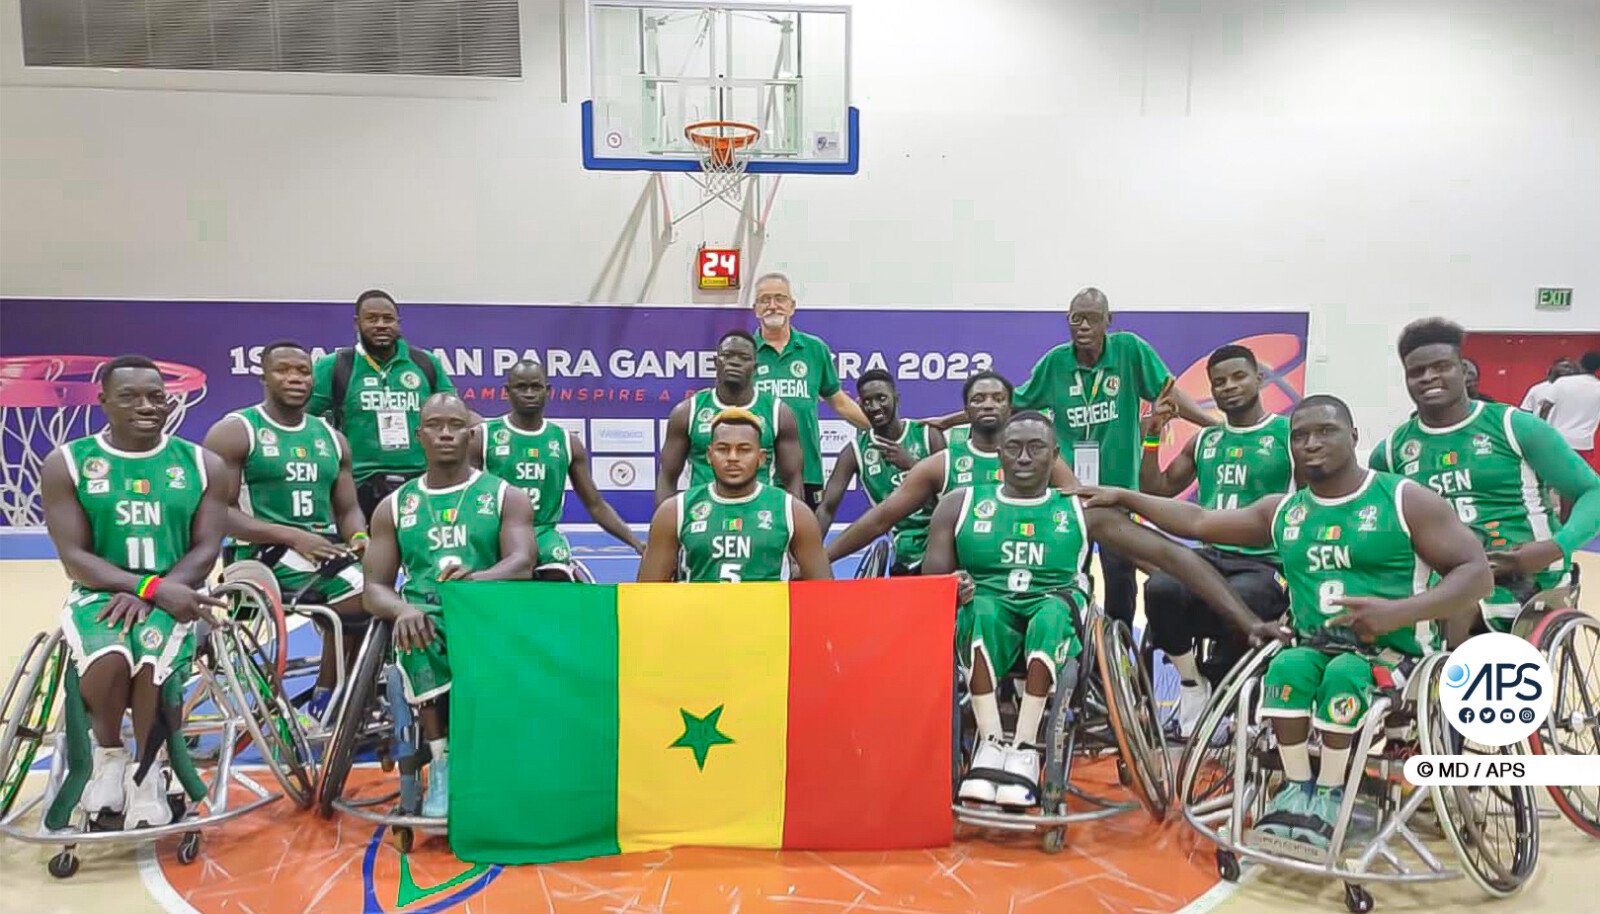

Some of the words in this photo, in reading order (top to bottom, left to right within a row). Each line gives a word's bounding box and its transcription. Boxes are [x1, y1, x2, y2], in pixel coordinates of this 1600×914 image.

[703, 252, 736, 276] 24
[1541, 290, 1572, 306] EXIT
[230, 346, 265, 376] 1S
[608, 349, 717, 379] GAME
[897, 352, 993, 380] 2023
[285, 461, 318, 482] SEN
[516, 462, 546, 480] SEN
[1216, 463, 1247, 486] SEN
[1428, 468, 1472, 495] SEN
[115, 500, 161, 526] SEN
[292, 490, 314, 517] 15
[427, 524, 467, 551] SEN
[711, 535, 751, 559] SEN
[126, 537, 156, 569] 11
[1000, 540, 1044, 566] SEN
[1306, 545, 1352, 573] SEN
